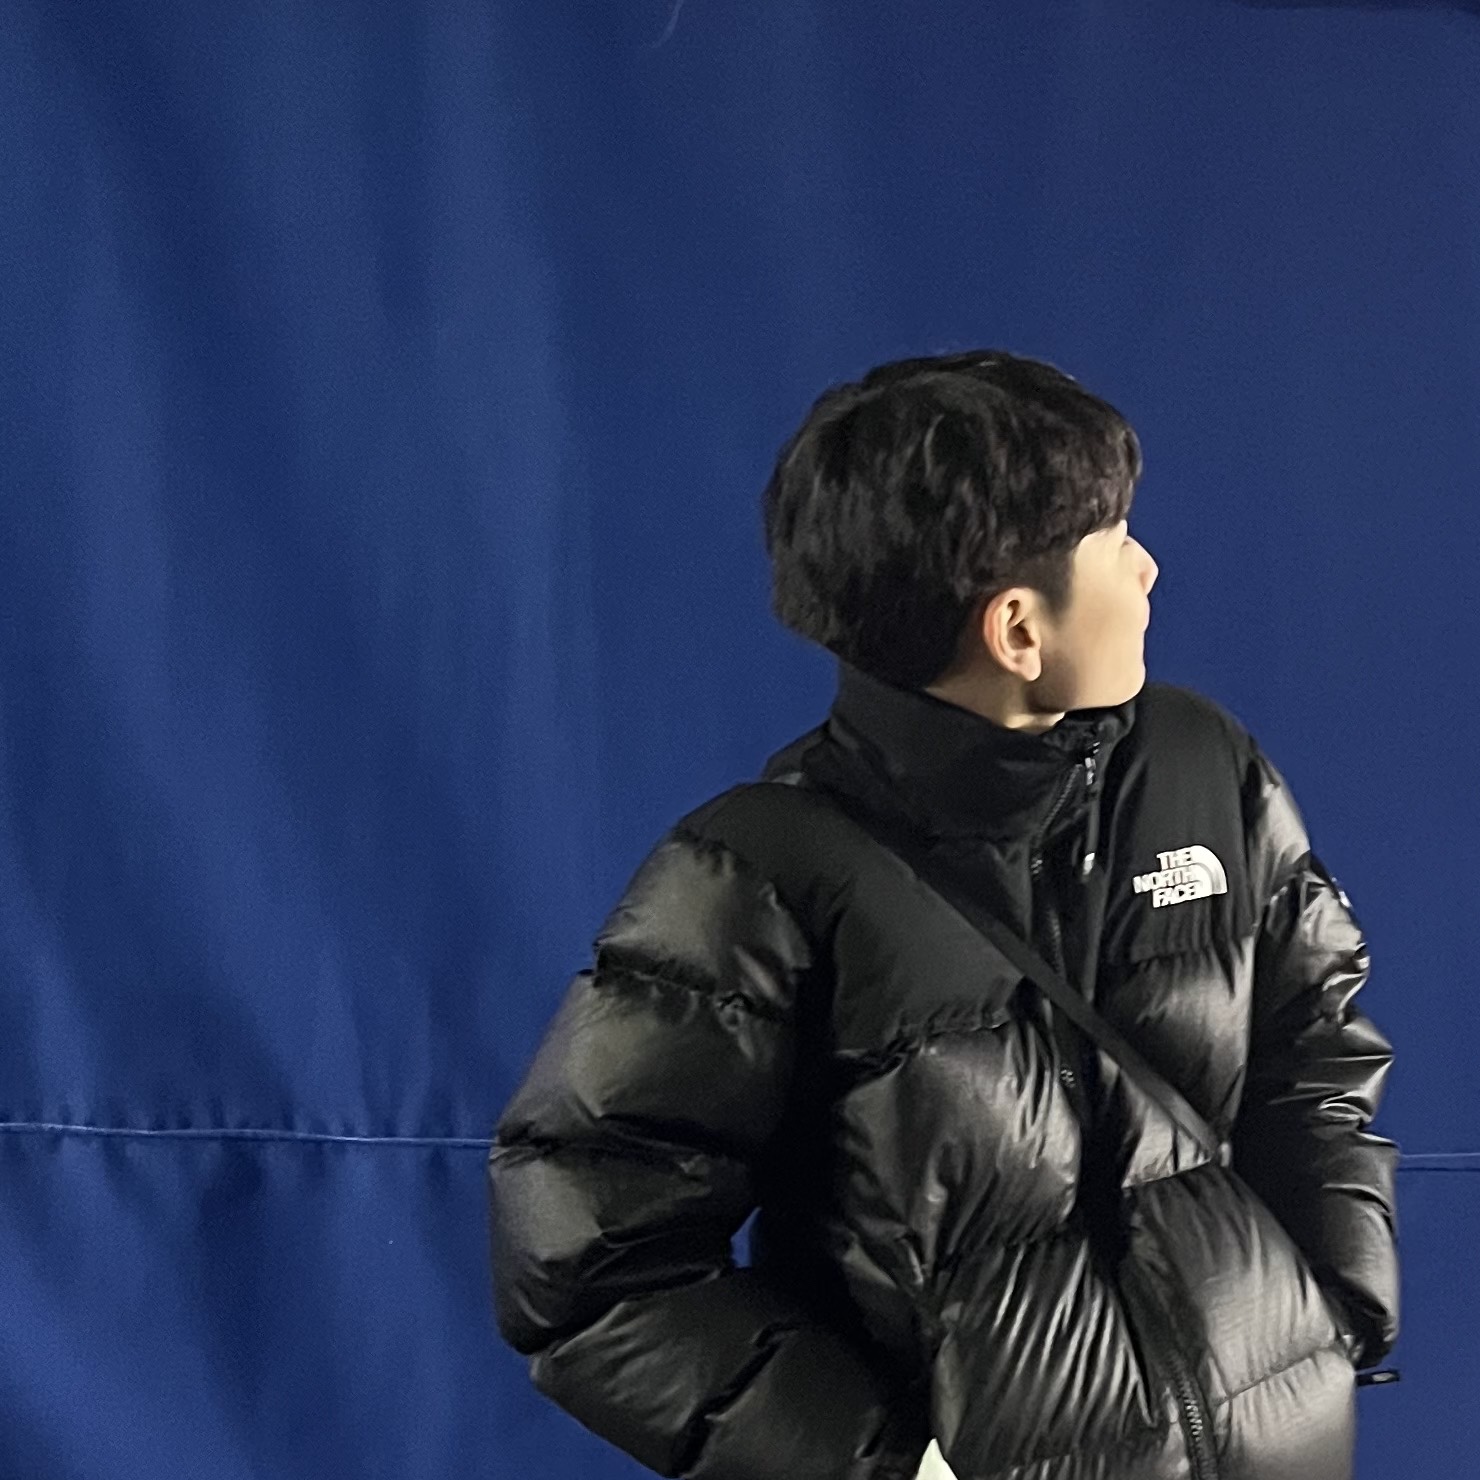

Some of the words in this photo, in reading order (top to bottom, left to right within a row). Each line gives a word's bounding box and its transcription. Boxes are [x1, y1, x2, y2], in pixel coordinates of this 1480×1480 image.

[1156, 847, 1194, 871] THE
[1133, 865, 1195, 893] NORTH
[1152, 884, 1197, 908] FACE
